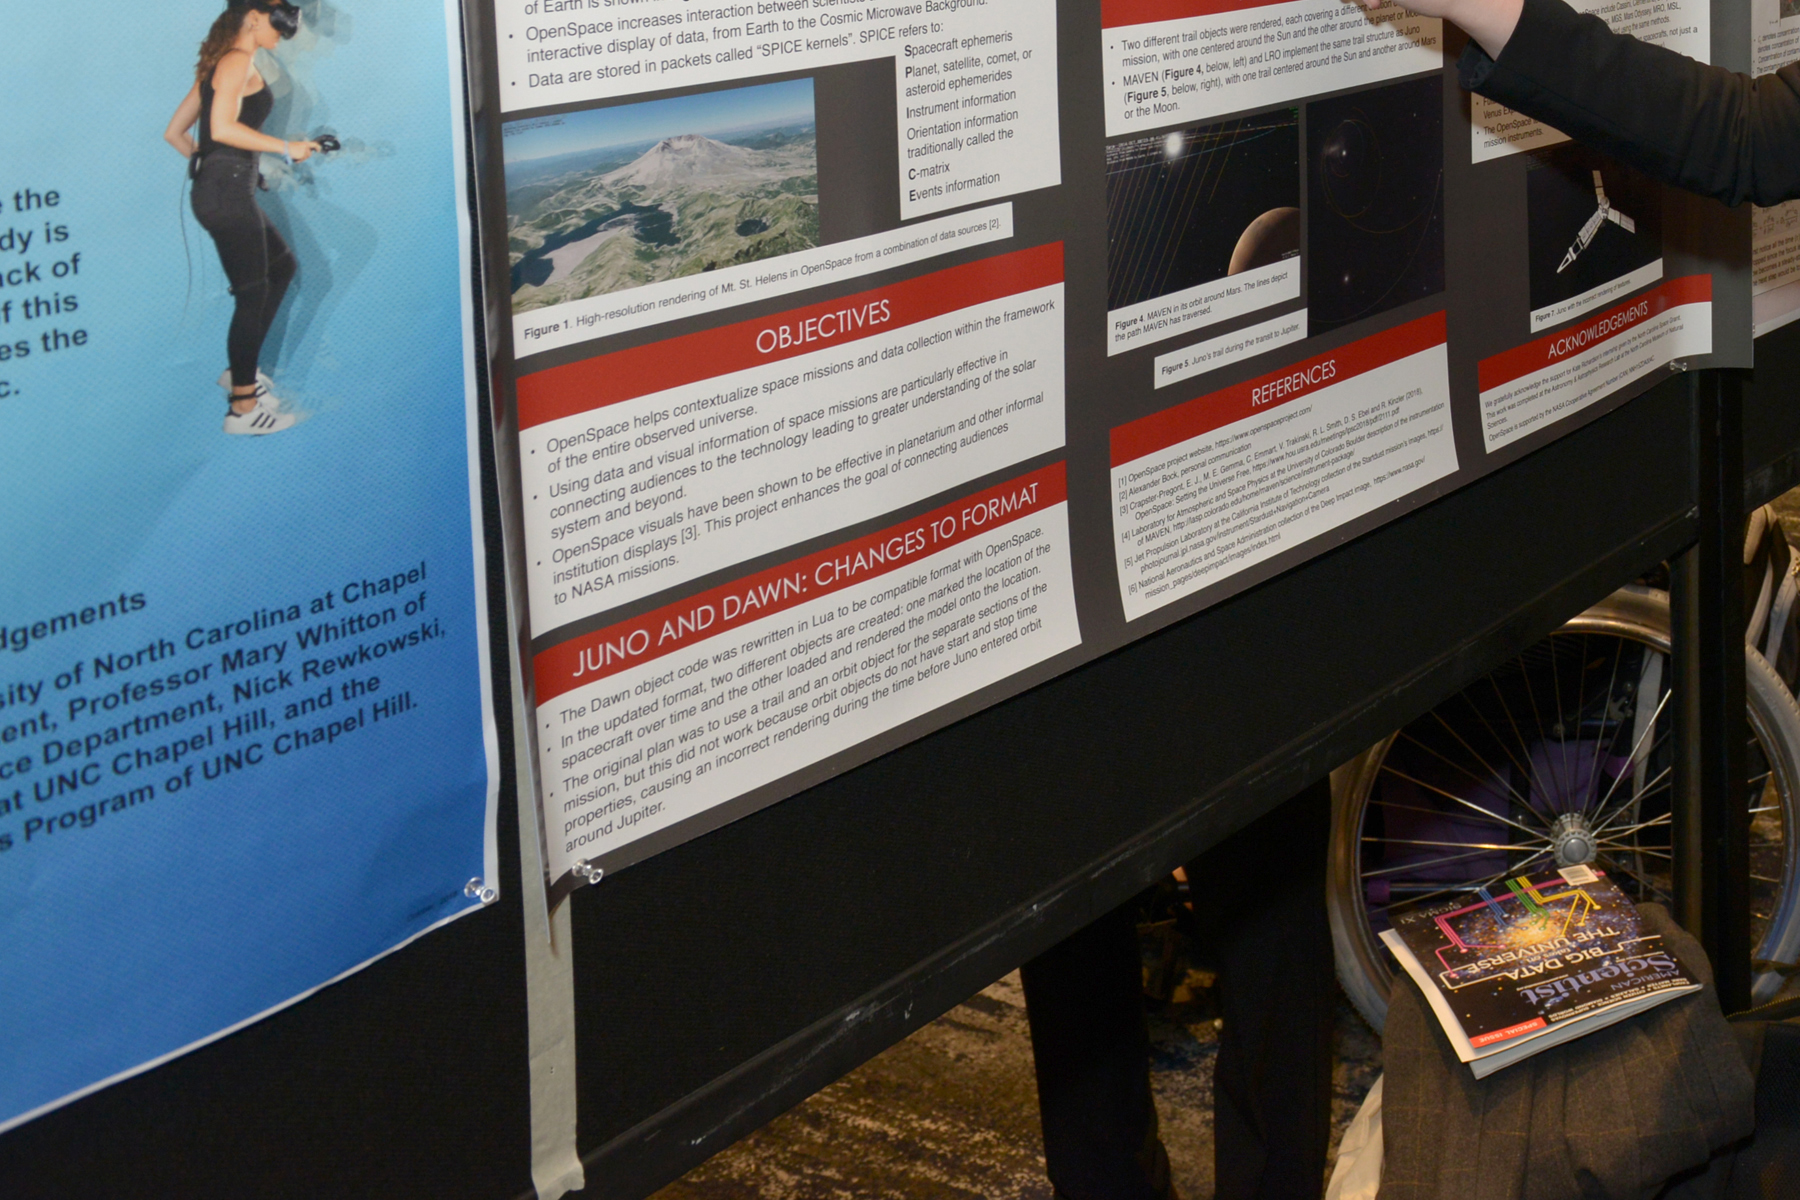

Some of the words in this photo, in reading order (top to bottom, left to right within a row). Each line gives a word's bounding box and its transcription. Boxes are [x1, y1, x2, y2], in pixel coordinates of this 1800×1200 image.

[756, 299, 890, 353] OBJECTIVES
[1548, 300, 1648, 359] ACKNOWLEDGEMENTS
[1252, 359, 1336, 407] REFERENCES
[572, 629, 649, 677] JUNO
[658, 605, 715, 646] AND
[723, 572, 807, 621] DAWN:
[815, 528, 925, 586] CHANGES
[930, 516, 956, 543] TO
[962, 482, 1038, 531] FORMAT
[54, 661, 84, 690] of
[94, 638, 175, 679] North
[185, 605, 301, 650] Carolina
[310, 590, 335, 614] at
[342, 560, 426, 604] Chapel
[24, 785, 155, 842] Program
[165, 764, 193, 793] of
[202, 743, 264, 780] UNC
[273, 708, 364, 755] Chapel
[372, 691, 418, 722] Hill.
[1399, 914, 1415, 925] XI
[1418, 902, 1462, 919] SIGMA
[1574, 926, 1620, 944] THE
[1467, 937, 1572, 974] UNIVERSE
[1504, 960, 1563, 980] DATA
[1564, 946, 1605, 966] BIG
[1519, 952, 1676, 1006] Scientist
[1610, 969, 1681, 991] AMERICAN
[1478, 1031, 1503, 1044] ISSUE
[1505, 1020, 1538, 1036] SPECIAL
